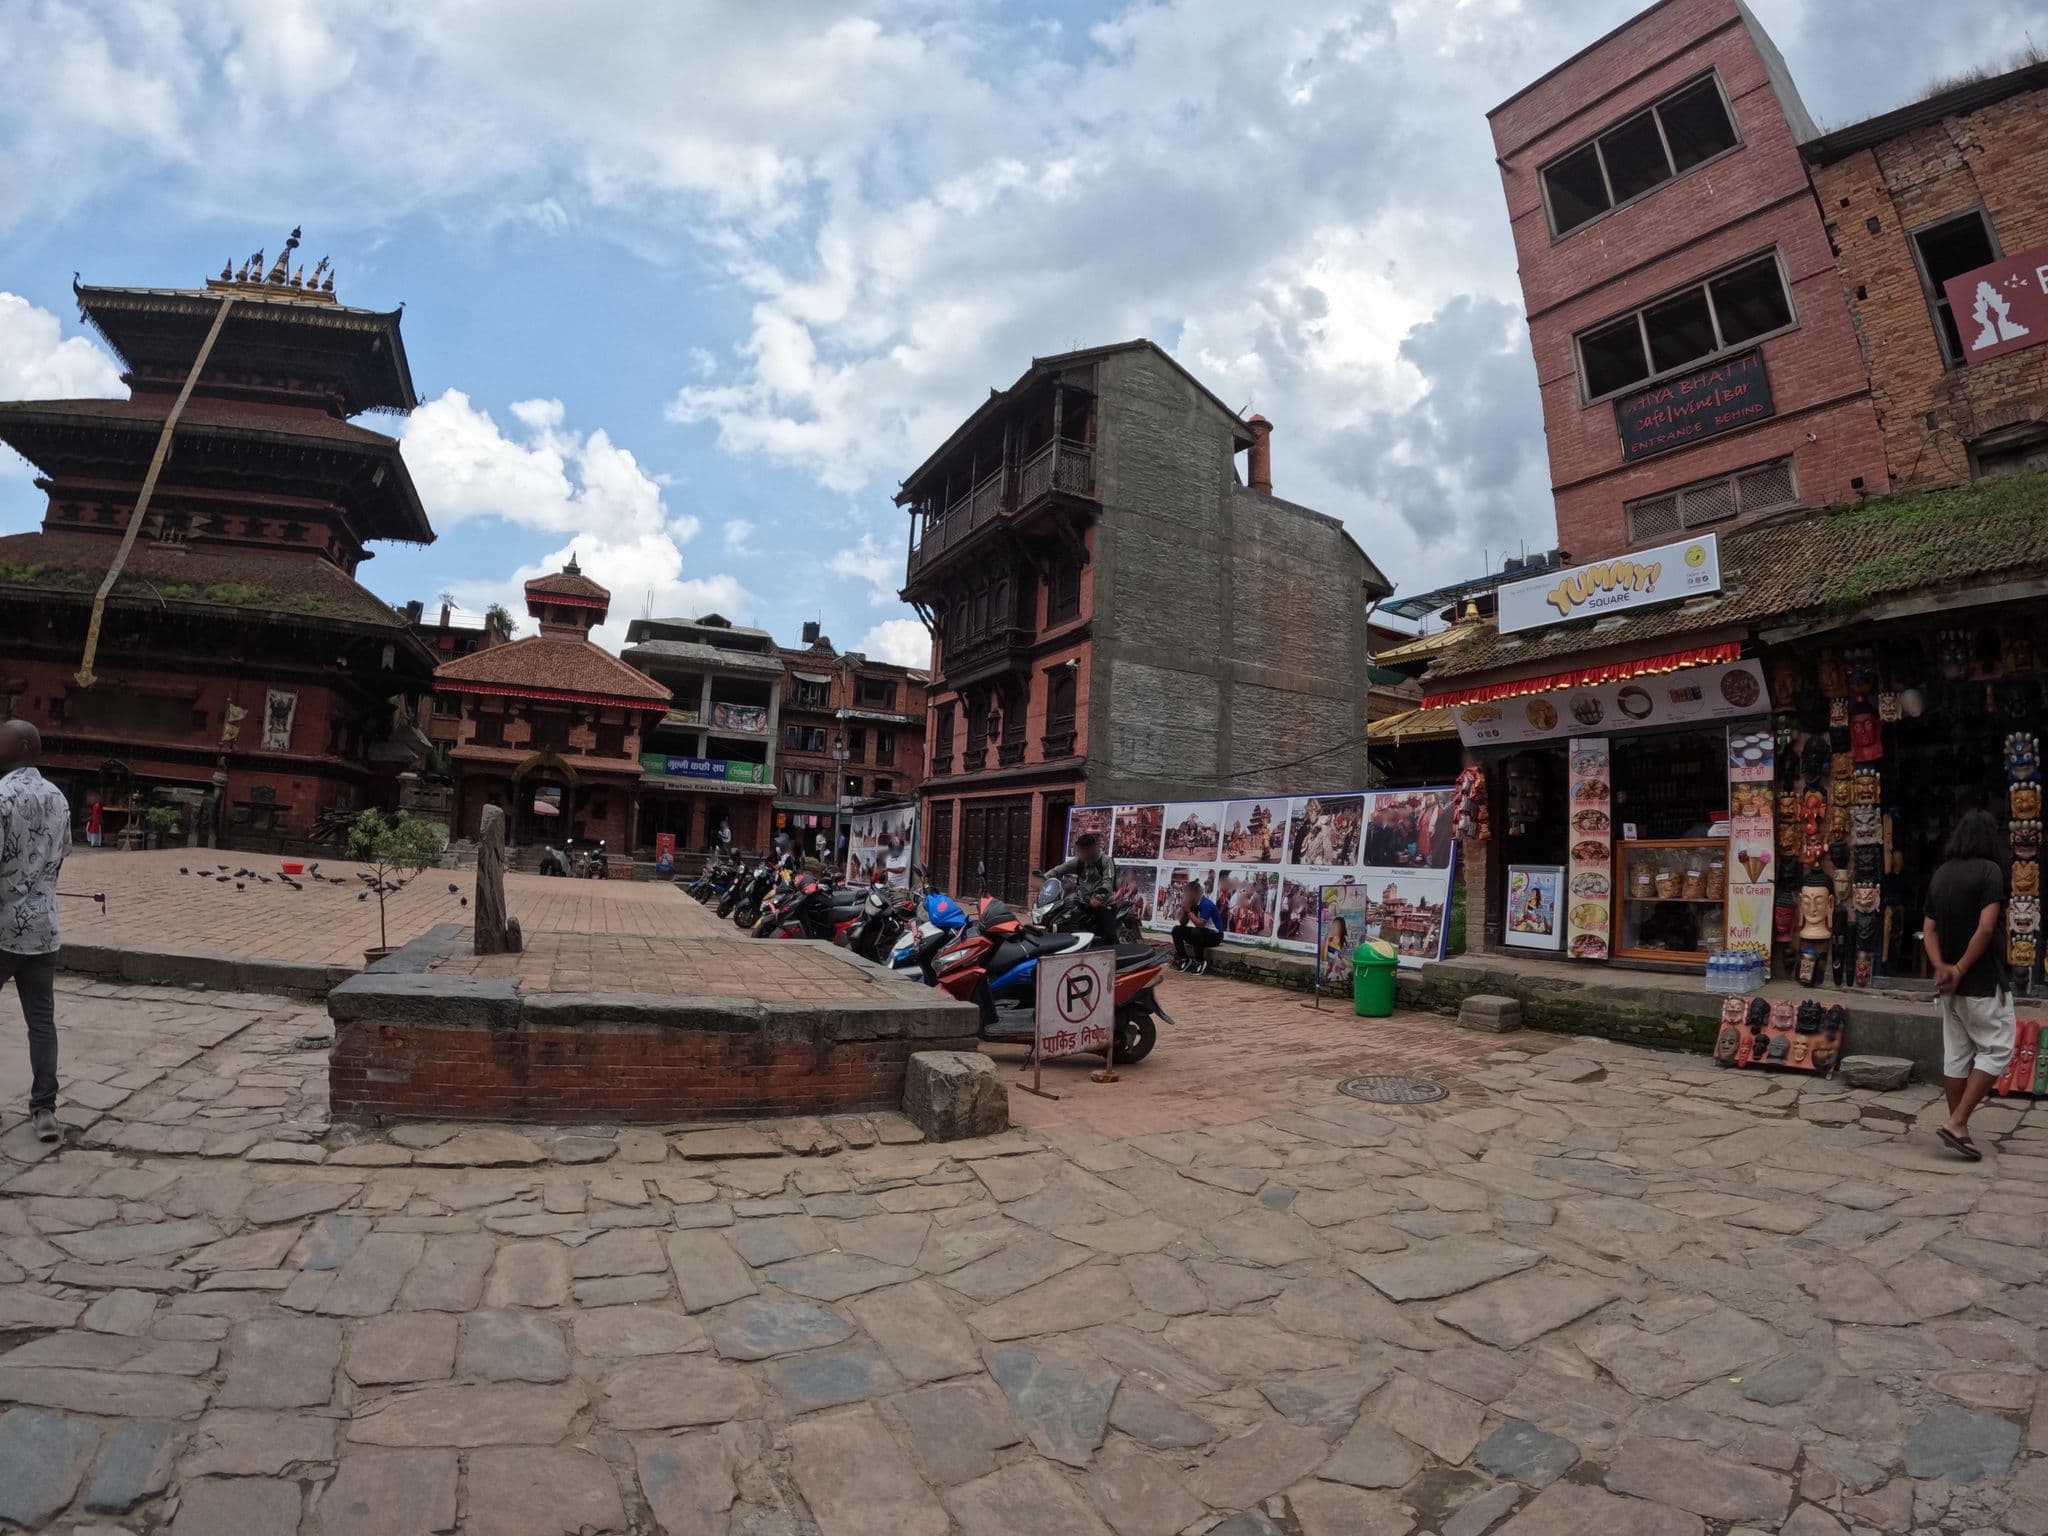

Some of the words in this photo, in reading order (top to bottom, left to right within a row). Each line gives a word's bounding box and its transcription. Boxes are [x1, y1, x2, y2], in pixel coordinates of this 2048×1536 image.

[1680, 355, 1758, 394] BHATTI
[1631, 422, 1703, 452] ENTRANCE
[1714, 403, 1764, 425] BEHIND
[1547, 560, 1662, 616] YUMMY!
[1588, 592, 1631, 609] SQUARE
[1733, 886, 1745, 895] Ice
[1745, 885, 1771, 896] Cream
[1729, 926, 1752, 938] Kulfi
